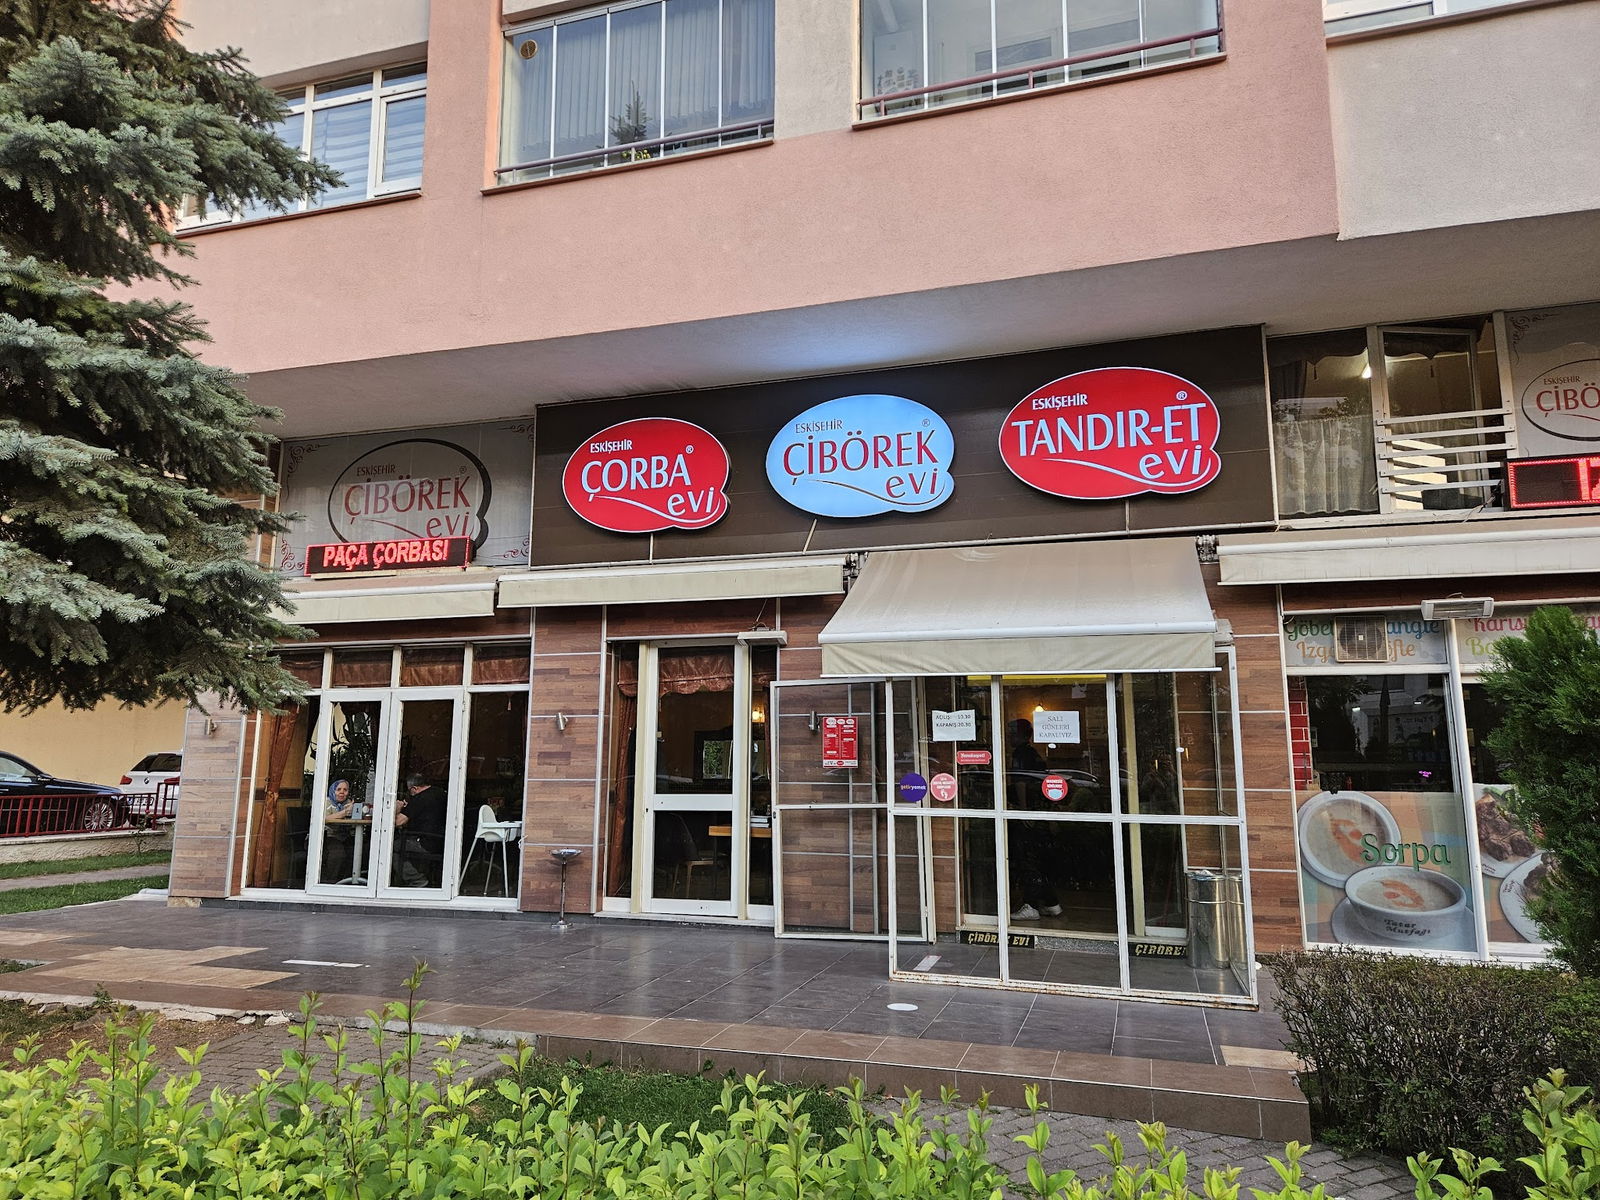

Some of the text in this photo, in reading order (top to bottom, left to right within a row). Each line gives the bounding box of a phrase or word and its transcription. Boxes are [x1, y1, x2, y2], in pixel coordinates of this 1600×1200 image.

[1032, 392, 1088, 411] ESKİŞEHİR
[795, 418, 843, 434] ESKİŞEHİR
[1011, 402, 1207, 457] TANDIR-ET
[590, 438, 633, 454] ESKİŞEHİR
[783, 429, 939, 486] ÇİBÖREK
[1139, 444, 1203, 479] evi
[357, 464, 396, 477] ESKİŞEHİR
[581, 453, 692, 502] ÇORBA
[885, 468, 938, 499] evi
[344, 474, 471, 525] ÇİBÖREK
[667, 486, 715, 516] evi
[426, 511, 470, 538] evi
[323, 539, 449, 571] PAÇA ÇORBASI
[1360, 834, 1451, 872] Sorpa
